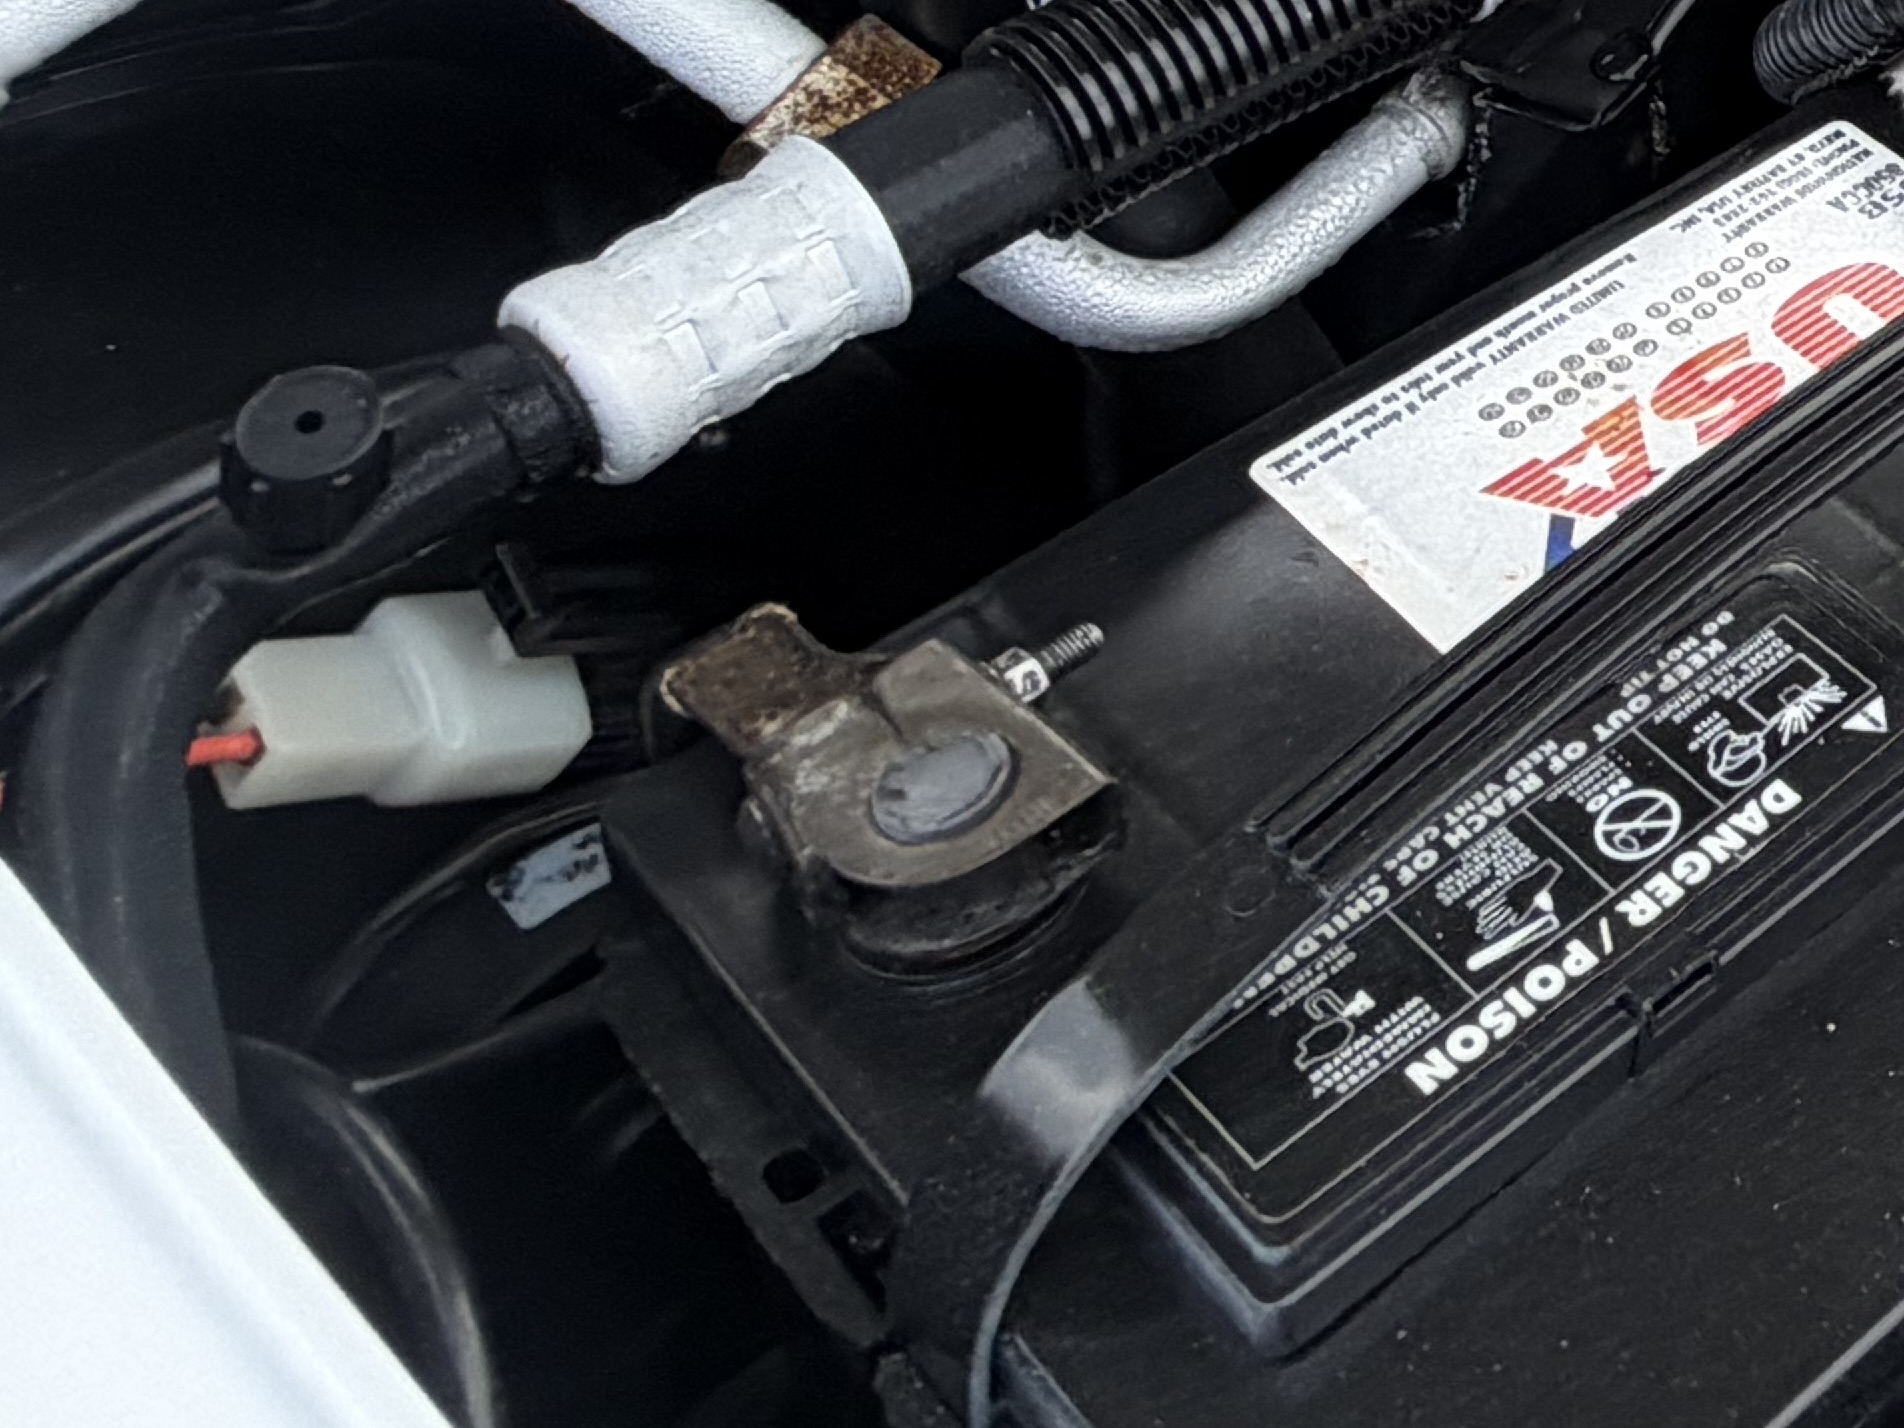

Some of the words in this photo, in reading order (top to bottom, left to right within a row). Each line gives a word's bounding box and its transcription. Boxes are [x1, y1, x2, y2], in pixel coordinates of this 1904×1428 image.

[1719, 194, 1796, 243] WARRANTY
[1582, 252, 1637, 287] Remove
[1533, 281, 1582, 312] proper
[1567, 279, 1625, 316] LIMITED
[1486, 311, 1571, 365] WARRANTY
[1493, 309, 1541, 340] month
[1465, 336, 1497, 357] and
[1449, 360, 1490, 387] valid
[1380, 391, 1403, 408] to
[1415, 380, 1452, 406] only
[1339, 403, 1383, 432] show
[1360, 408, 1406, 440] dated
[1316, 434, 1364, 466] when
[1697, 609, 1737, 638] DO
[1650, 634, 1701, 673] NOT
[1652, 637, 1727, 694] KEEP
[1615, 667, 1657, 699] TIP
[1587, 691, 1655, 742] OUT
[1499, 737, 1559, 782] KEEP
[1542, 737, 1591, 775] OF
[1440, 779, 1502, 827] VENT
[1442, 771, 1545, 850] REACH
[1582, 774, 1634, 815] NO
[1391, 846, 1443, 887] OF
[1613, 778, 1803, 928] DANGER
[1371, 993, 1423, 1034] WITH
[1403, 937, 1599, 1095] POISON
[1307, 1033, 1371, 1083] WATER
